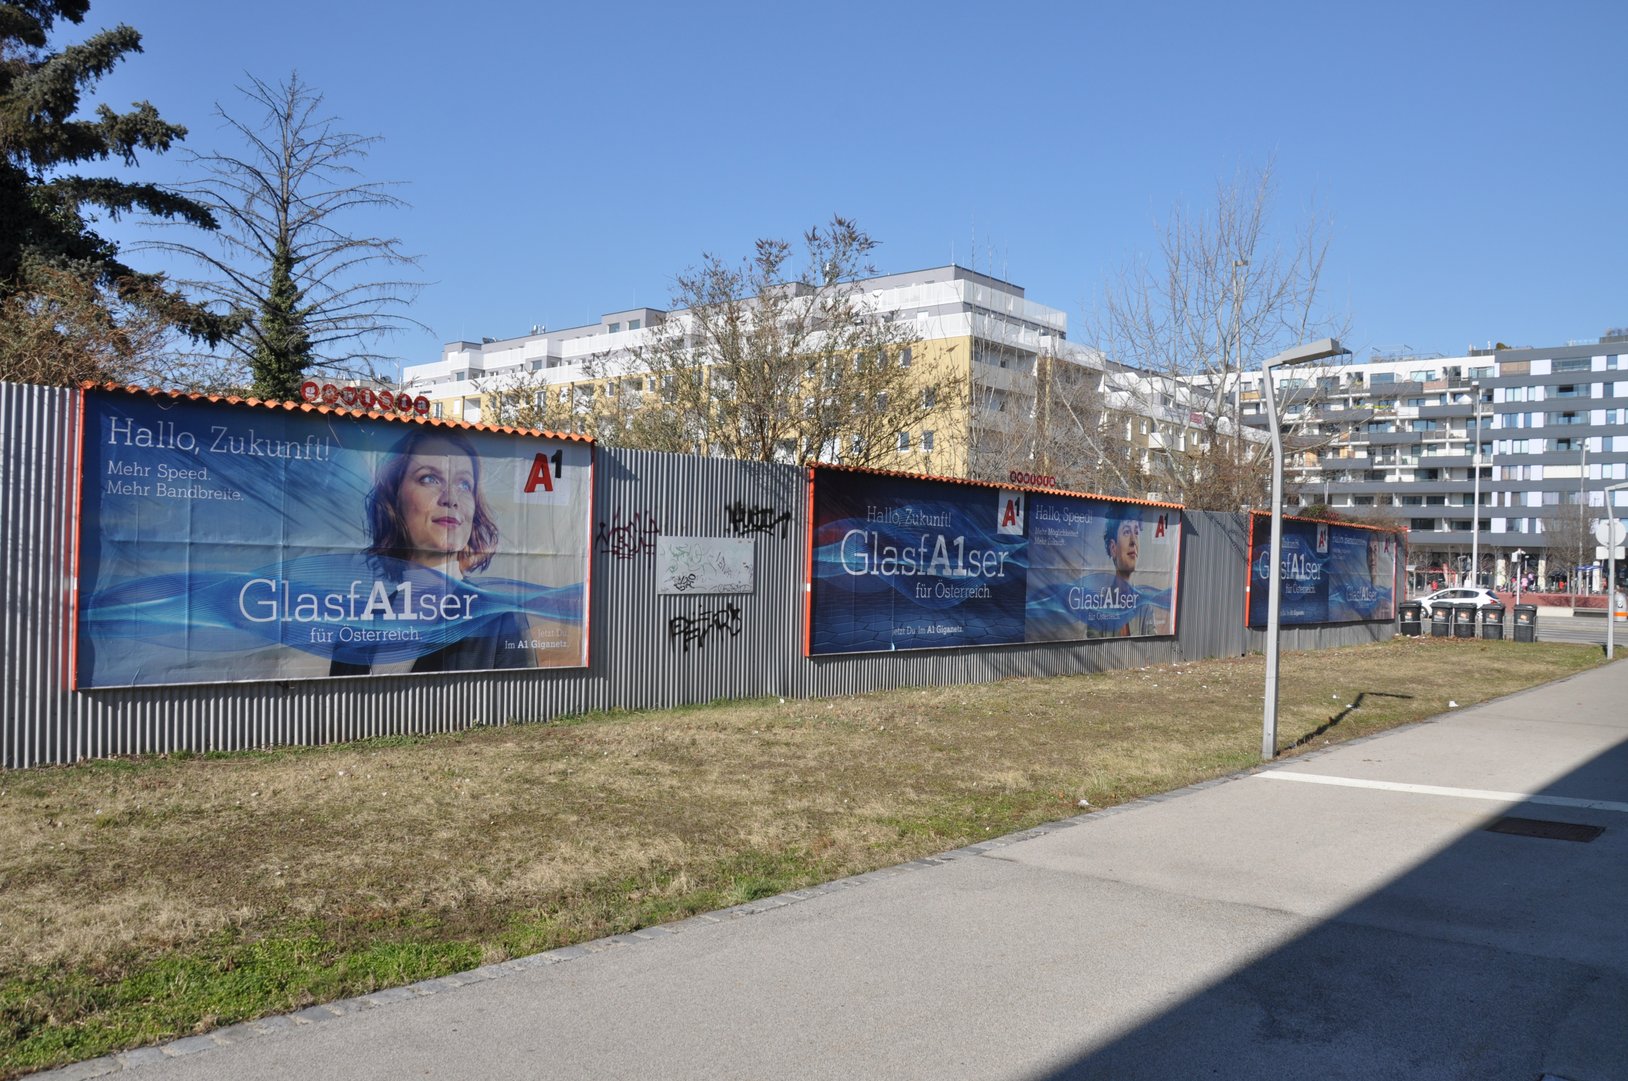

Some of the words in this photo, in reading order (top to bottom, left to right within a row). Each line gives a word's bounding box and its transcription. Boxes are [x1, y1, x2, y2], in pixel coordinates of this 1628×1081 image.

[108, 416, 201, 455] Hallo,
[209, 426, 330, 462] Zukunft!
[107, 461, 150, 476] Mehr
[157, 464, 212, 482] Speed.
[524, 449, 563, 493] A1
[107, 480, 150, 496] Mehr
[156, 483, 245, 501] Bandbreite.
[867, 506, 901, 526] Hallo,
[905, 509, 952, 528] Zukunft!
[1002, 497, 1021, 527] A1
[1035, 504, 1061, 523] Hallo,
[1063, 507, 1093, 526] Speed!
[1155, 513, 1168, 538] A1
[840, 529, 1009, 577] GlasfA1ser
[1259, 551, 1322, 580] GsfA1ser
[239, 578, 478, 623] GlasfA1ser
[915, 583, 931, 598] für
[935, 580, 992, 599] Österreich.
[1068, 586, 1139, 610] GlasfA1ser
[310, 626, 333, 643] für
[339, 624, 423, 642] Österreich.
[927, 625, 935, 634] A1
[504, 640, 516, 649] Im
[518, 640, 529, 649] A1
